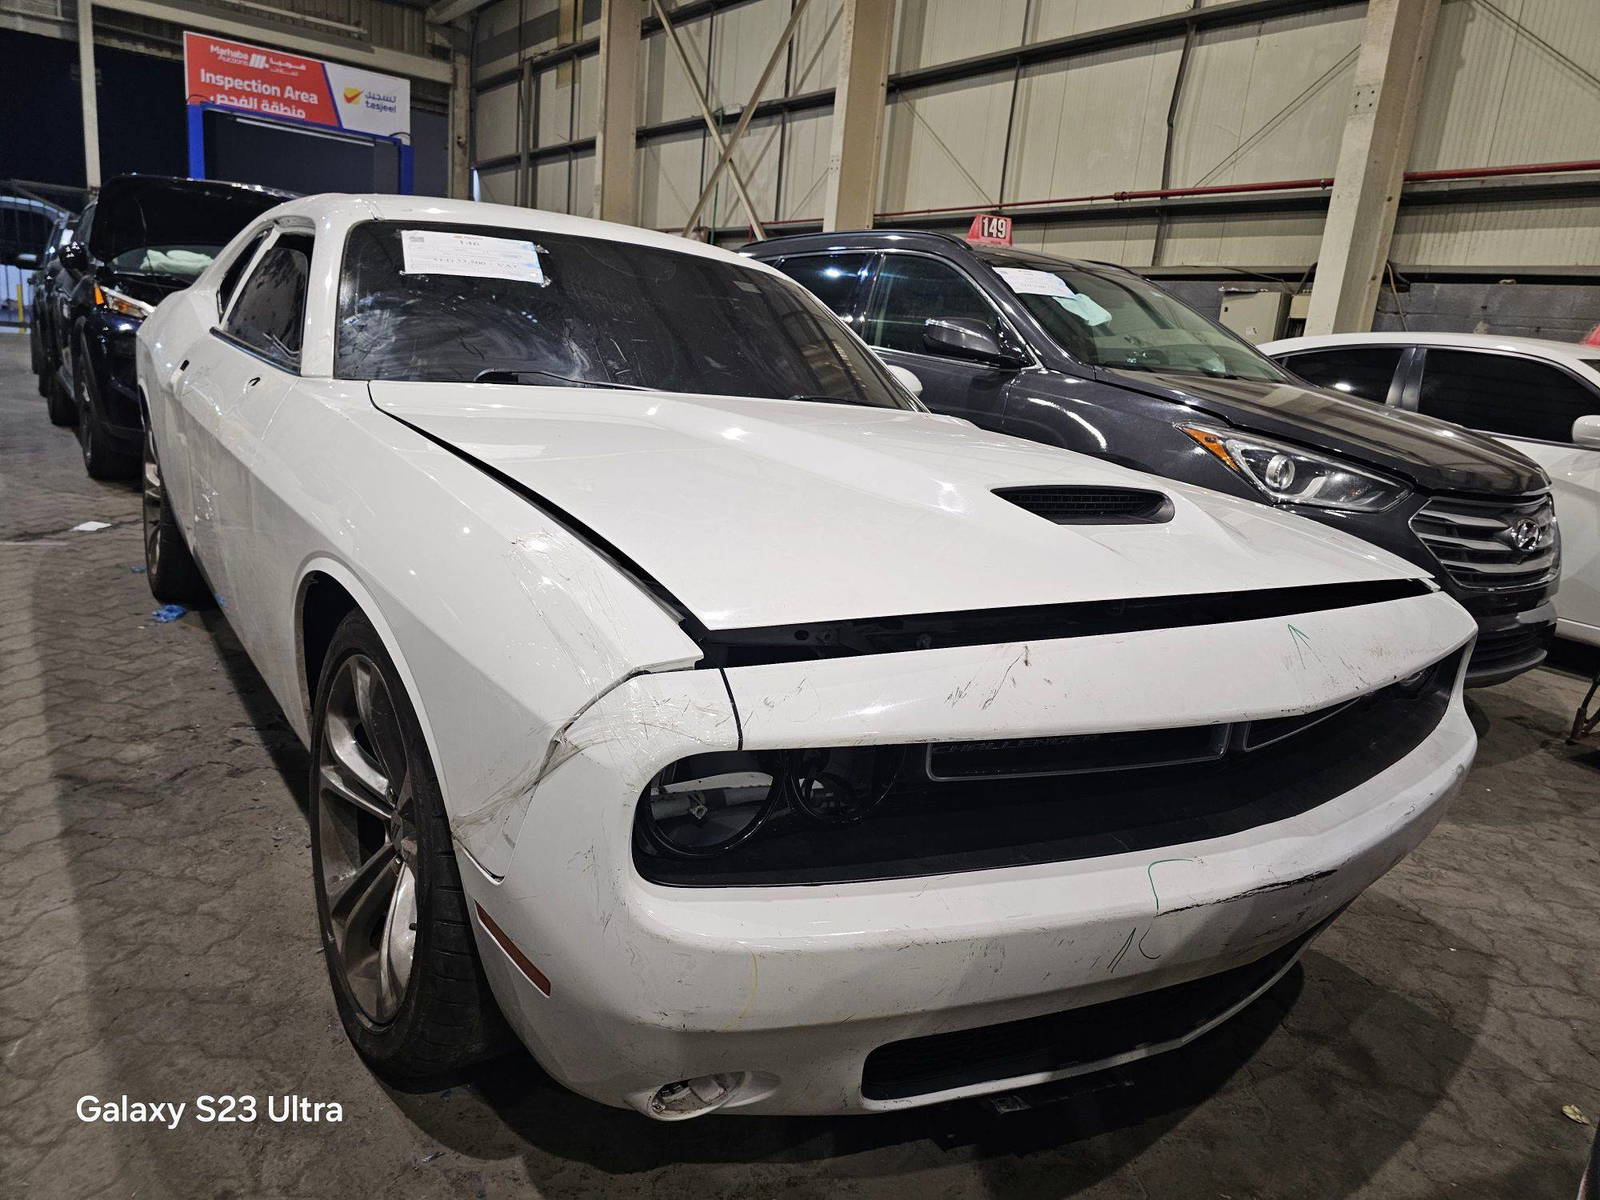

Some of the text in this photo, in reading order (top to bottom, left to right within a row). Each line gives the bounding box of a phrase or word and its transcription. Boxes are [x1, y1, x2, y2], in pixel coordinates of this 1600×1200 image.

[209, 44, 249, 60] Marhaba
[200, 68, 281, 97] Inspection
[284, 86, 318, 104] Area
[261, 98, 306, 119] منطقة
[982, 217, 1006, 238] 149
